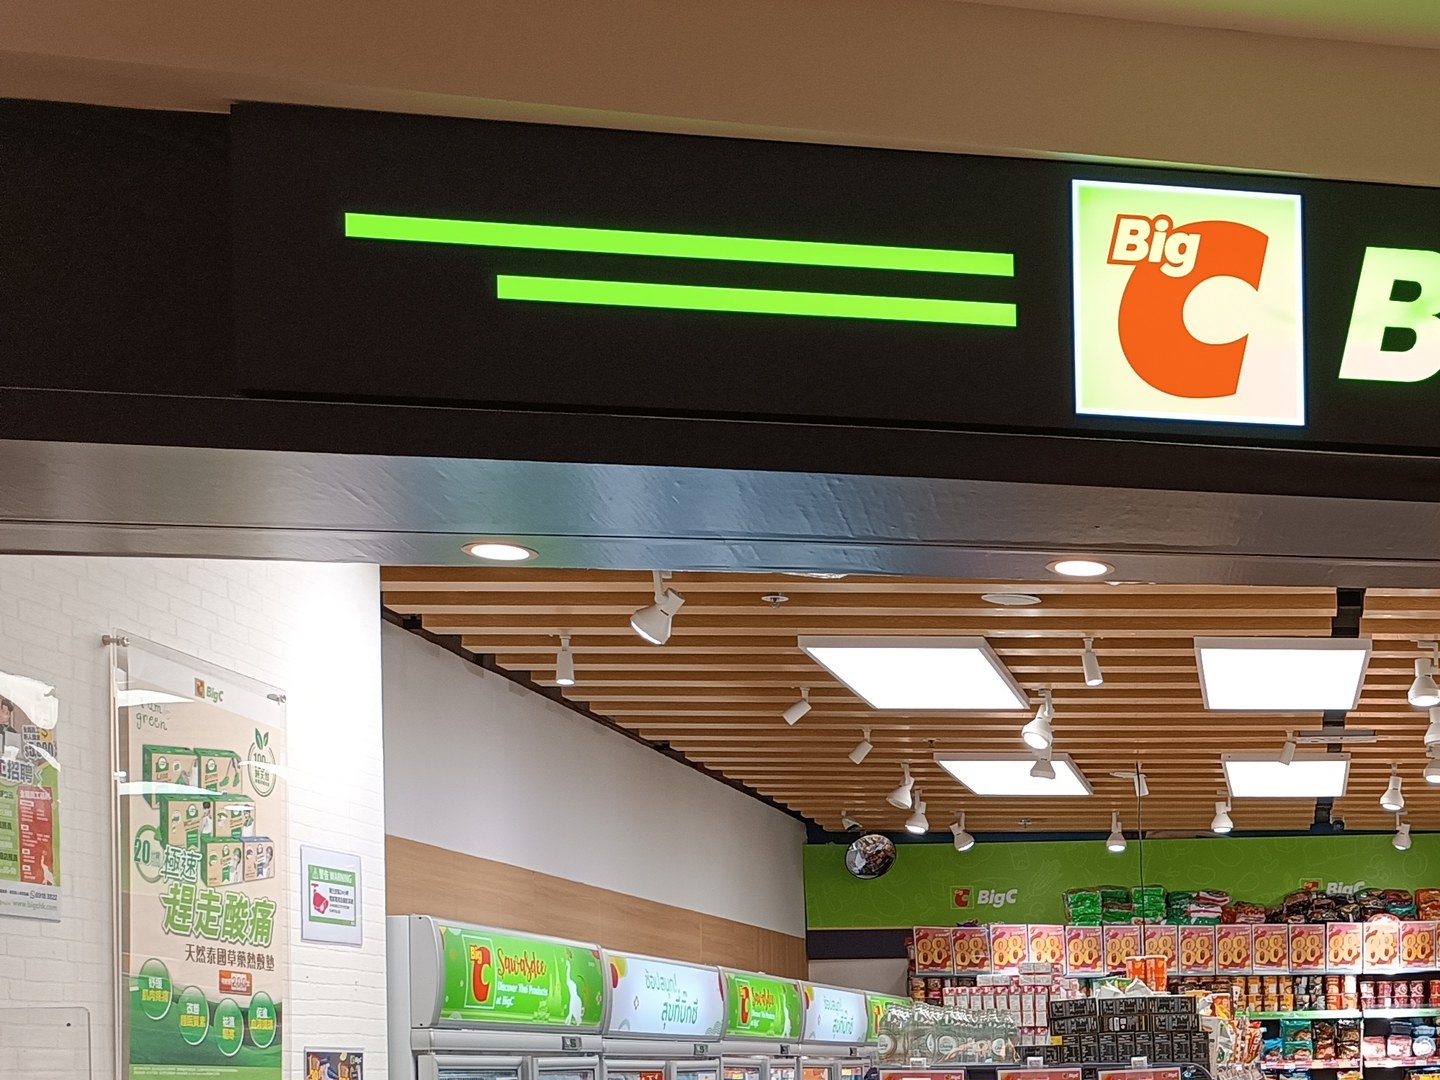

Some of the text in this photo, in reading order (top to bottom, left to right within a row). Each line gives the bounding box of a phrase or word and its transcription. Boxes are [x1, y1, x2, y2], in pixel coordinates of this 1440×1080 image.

[1108, 214, 1200, 278] Big
[206, 686, 224, 702] BigC
[136, 712, 167, 730] green
[134, 839, 150, 865] 20
[160, 845, 200, 883] 極速
[330, 871, 352, 883] WARNING
[977, 888, 1018, 908] BigC
[160, 883, 277, 948] 趕走酸痛
[918, 937, 950, 964] 88
[1068, 936, 1098, 964] 88
[1182, 936, 1210, 963] 88
[1255, 936, 1284, 964] 88
[1292, 936, 1320, 963] 88
[1402, 932, 1432, 960] 88
[497, 948, 546, 982] Sawasdee
